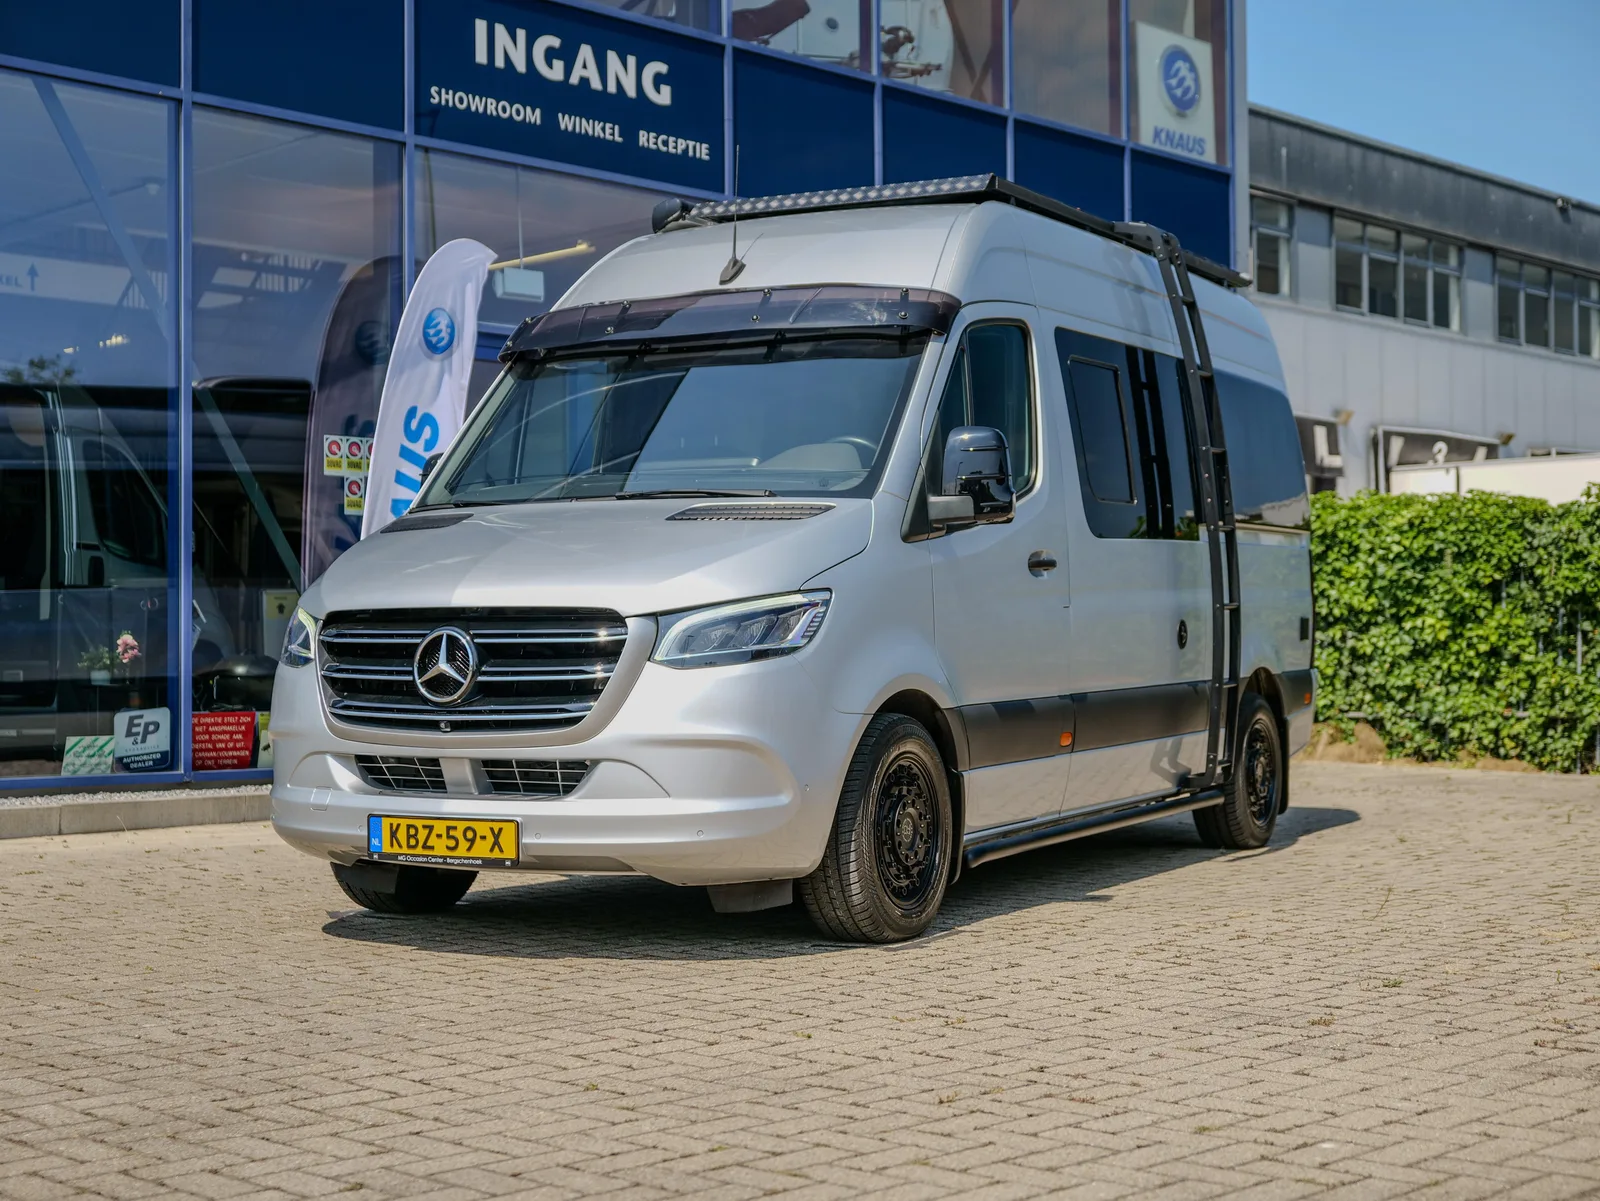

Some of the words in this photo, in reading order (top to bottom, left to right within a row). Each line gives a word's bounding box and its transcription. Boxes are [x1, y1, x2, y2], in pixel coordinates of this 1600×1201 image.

[474, 17, 672, 107] INGANG
[429, 85, 542, 126] SHOWROOM
[557, 112, 624, 143] WINKEL
[638, 129, 710, 161] RECEPTIE
[1152, 125, 1207, 156] KNAUS
[122, 753, 162, 764] AUTHORIZED
[129, 760, 154, 769] DEALER
[371, 837, 381, 846] NL
[389, 822, 505, 853] KBZ-59-X
[406, 855, 428, 863] Occasion
[446, 857, 483, 865] Bergschenhoek
